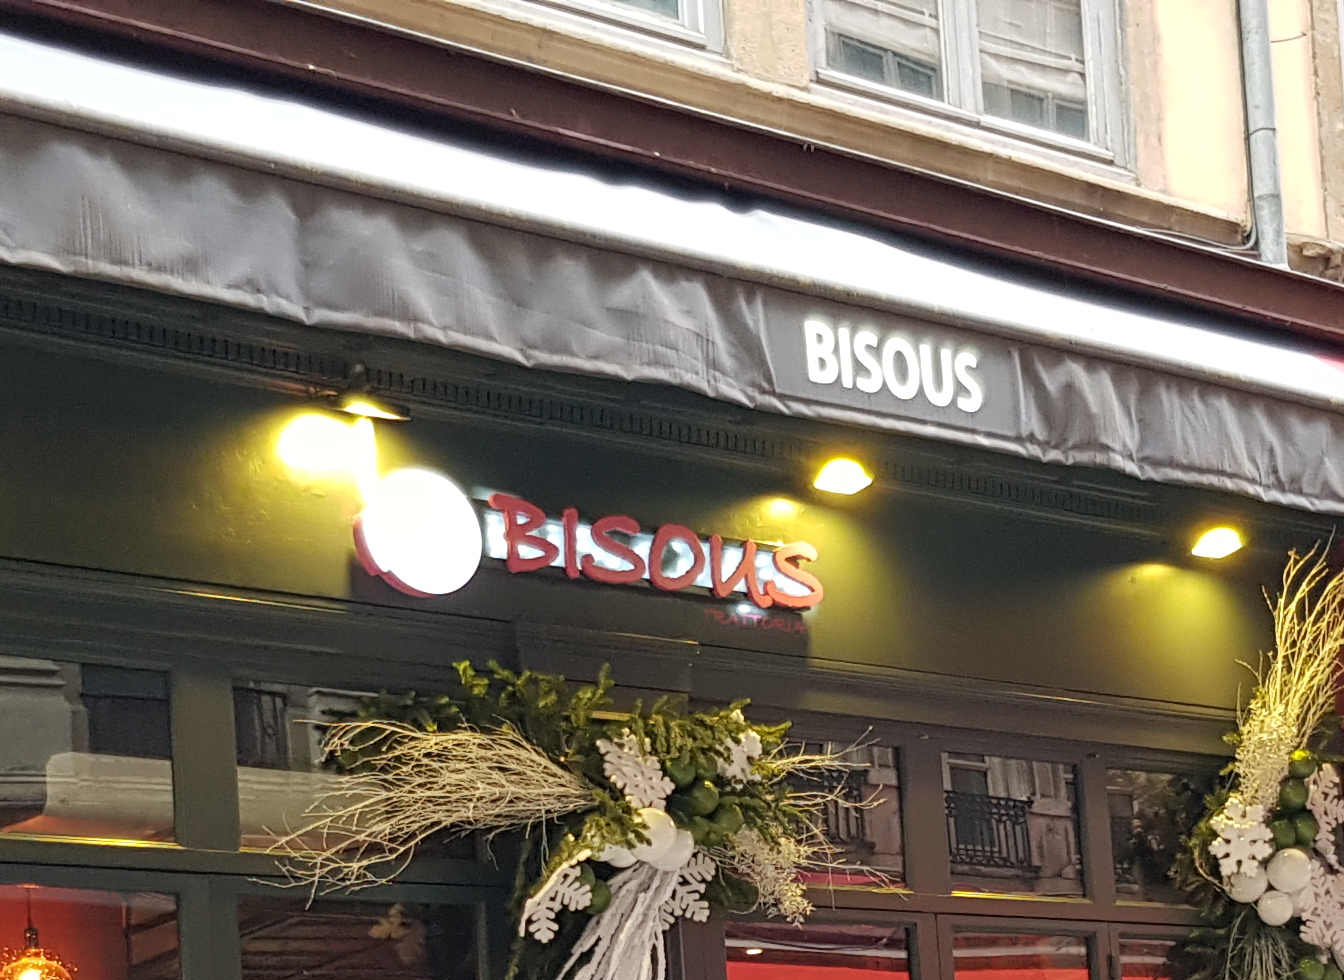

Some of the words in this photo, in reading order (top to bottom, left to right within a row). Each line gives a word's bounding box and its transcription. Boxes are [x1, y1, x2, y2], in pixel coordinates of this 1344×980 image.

[803, 319, 983, 414] BISOUS
[488, 493, 824, 609] BISOUS
[704, 608, 807, 633] TRATTORIA
